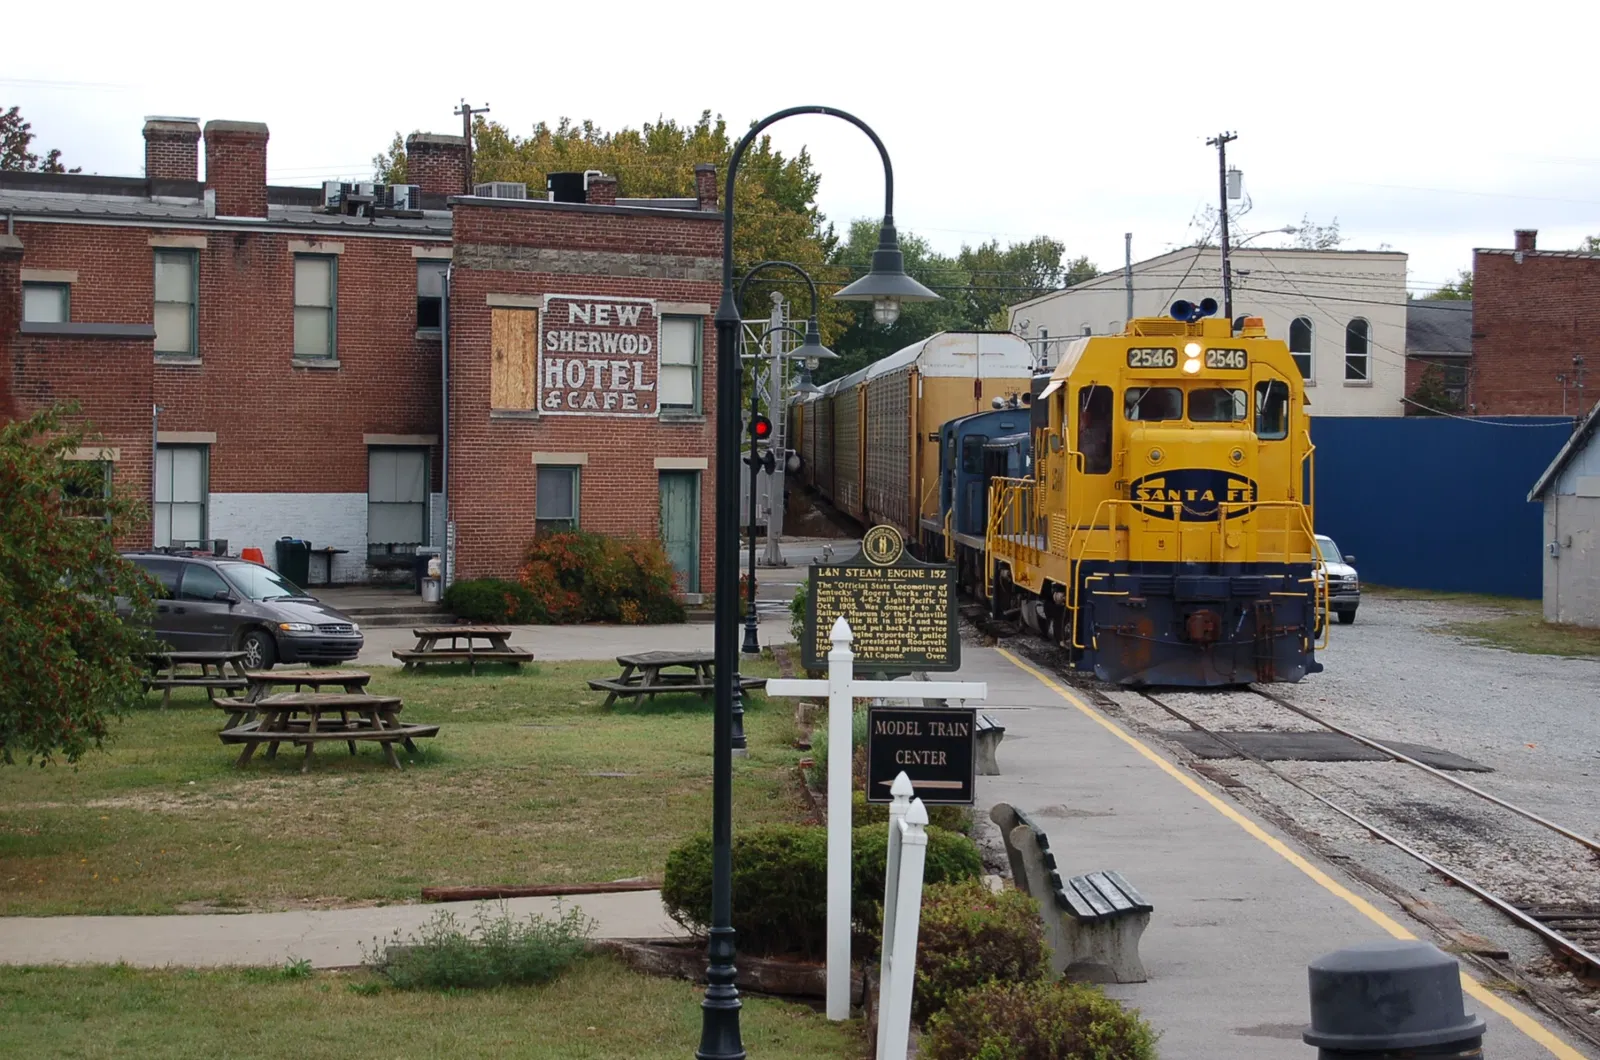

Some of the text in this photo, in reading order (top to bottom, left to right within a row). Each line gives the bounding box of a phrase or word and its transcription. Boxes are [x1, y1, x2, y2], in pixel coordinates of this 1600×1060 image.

[568, 303, 643, 326] NEW
[546, 330, 652, 354] SHERWOOD
[1131, 349, 1174, 367] 2546
[1207, 350, 1245, 368] 2546
[544, 358, 655, 391] HOTEL
[545, 391, 562, 409] &
[1136, 488, 1254, 502] SANTA FE
[818, 568, 946, 578] L&N STEAM ENGINE 152
[875, 721, 969, 737] MODEL TRAIN
[896, 750, 946, 765] CENTER
